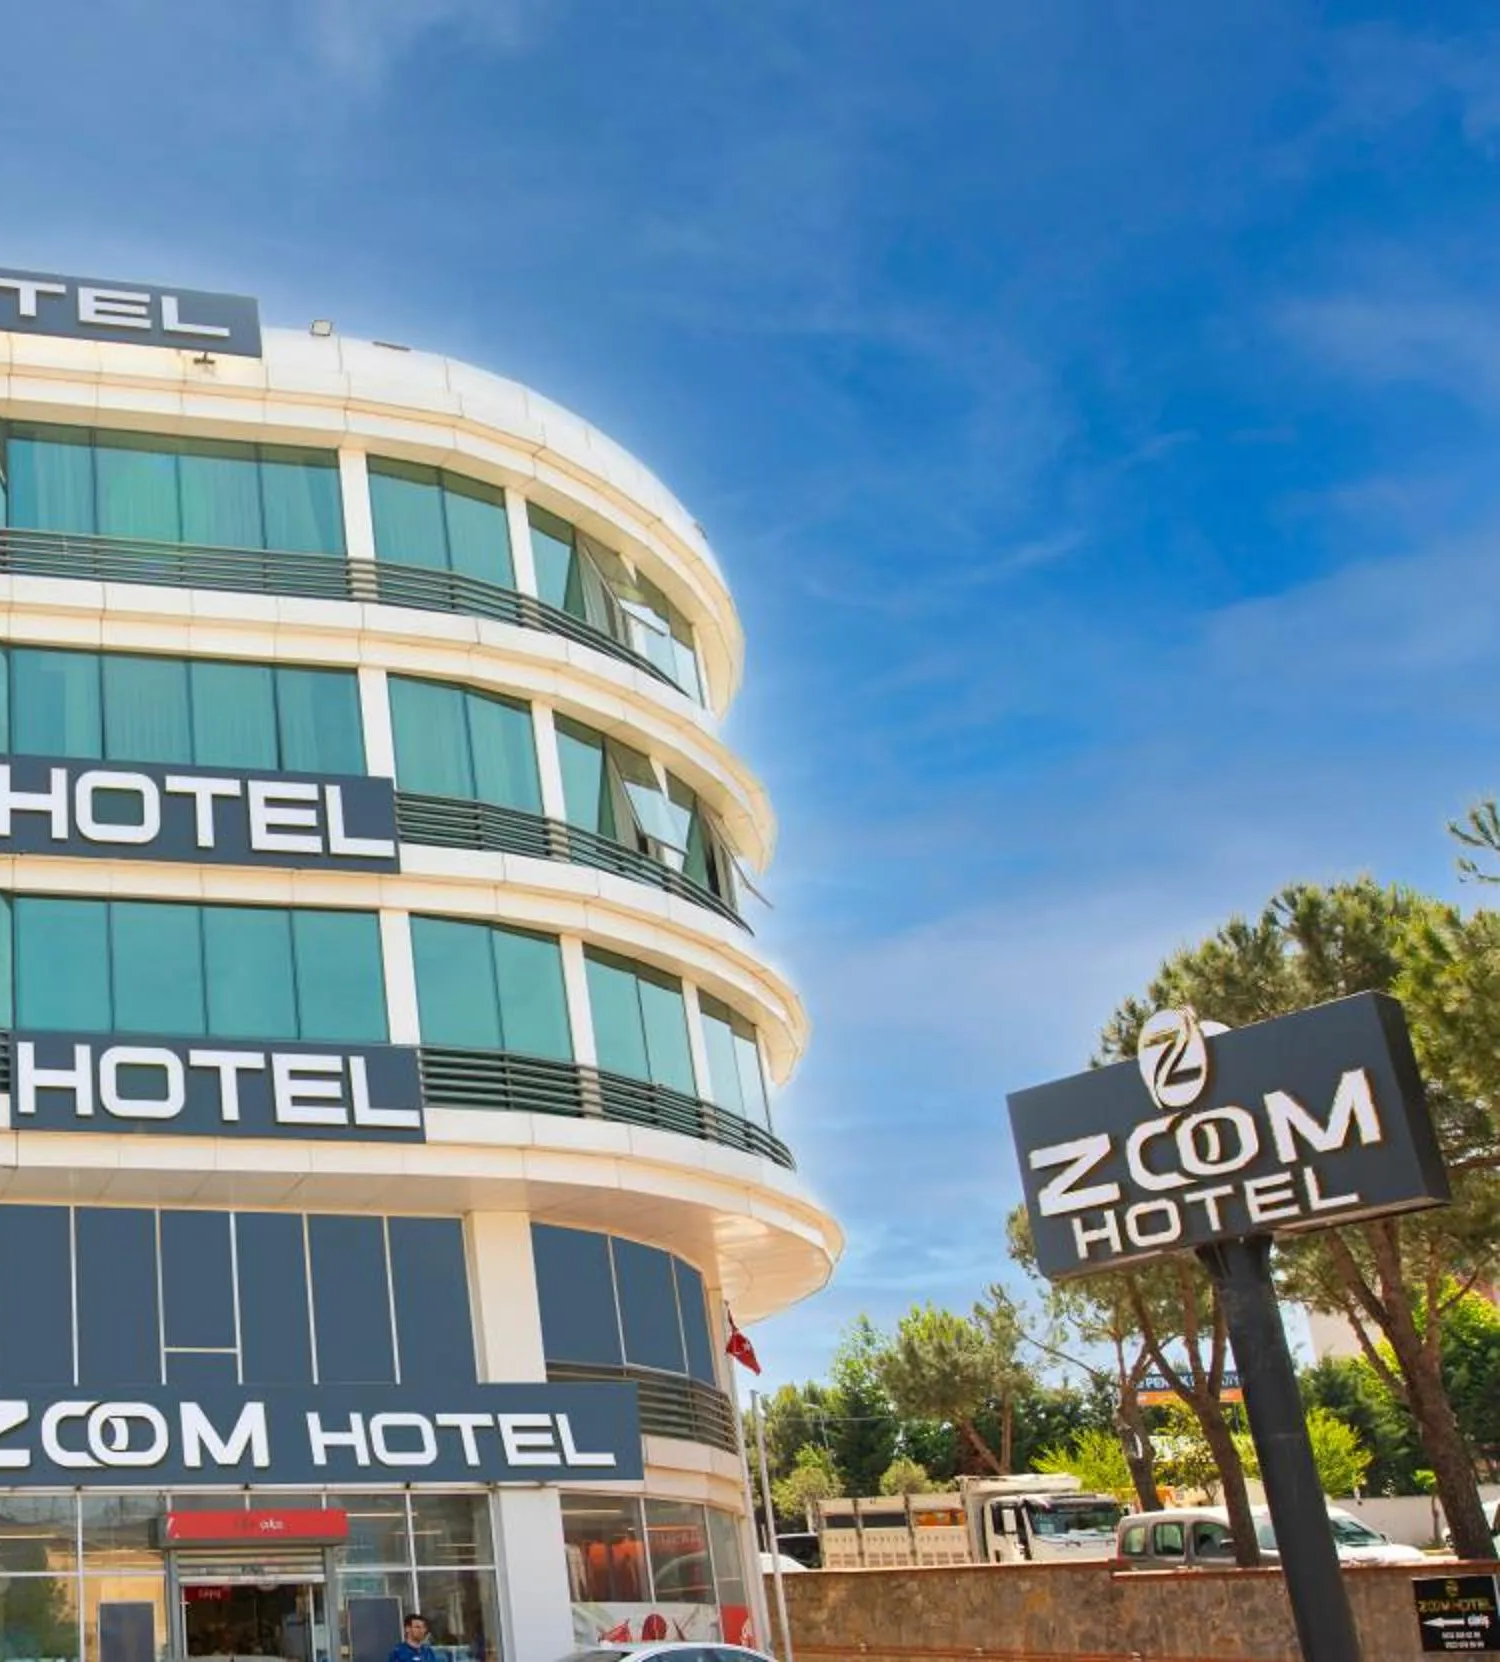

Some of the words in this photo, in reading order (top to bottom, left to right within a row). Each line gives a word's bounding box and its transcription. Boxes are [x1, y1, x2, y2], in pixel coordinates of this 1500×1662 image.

[16, 1040, 422, 1128] HOTEL
[1029, 1068, 1381, 1217] ZOOM
[1072, 1166, 1360, 1259] HOTEL
[305, 1411, 617, 1467] HOTEL
